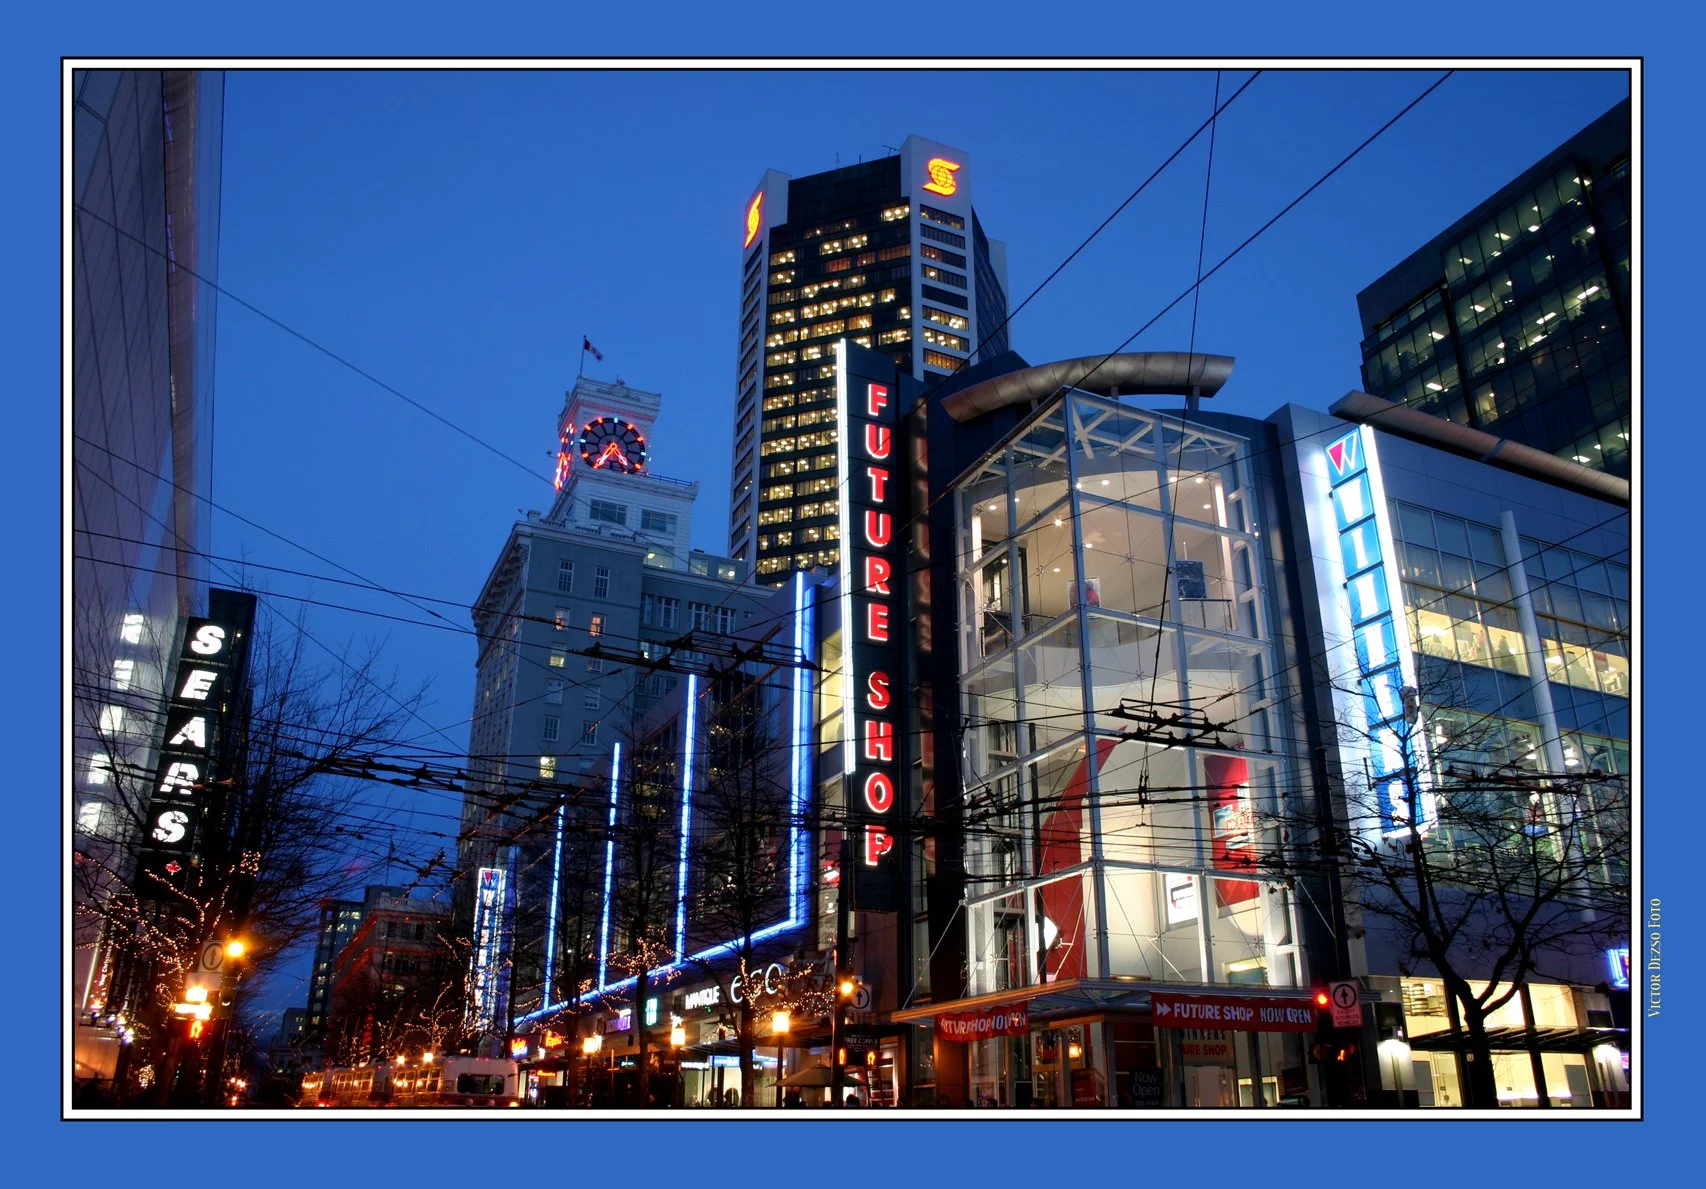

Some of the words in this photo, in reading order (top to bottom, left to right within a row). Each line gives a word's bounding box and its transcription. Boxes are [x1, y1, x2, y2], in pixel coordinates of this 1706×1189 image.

[864, 382, 892, 642] FUTURE
[152, 625, 225, 843] SEARS
[863, 670, 894, 867] SHOP
[1174, 1003, 1221, 1020] FUTURE
[1223, 1005, 1254, 1021] SHOP
[1260, 1007, 1285, 1023] NOW
[1286, 1007, 1312, 1024] OPEN
[1203, 1043, 1227, 1056] SHOP
[1134, 1071, 1157, 1084] Now
[1133, 1083, 1160, 1100] Open
